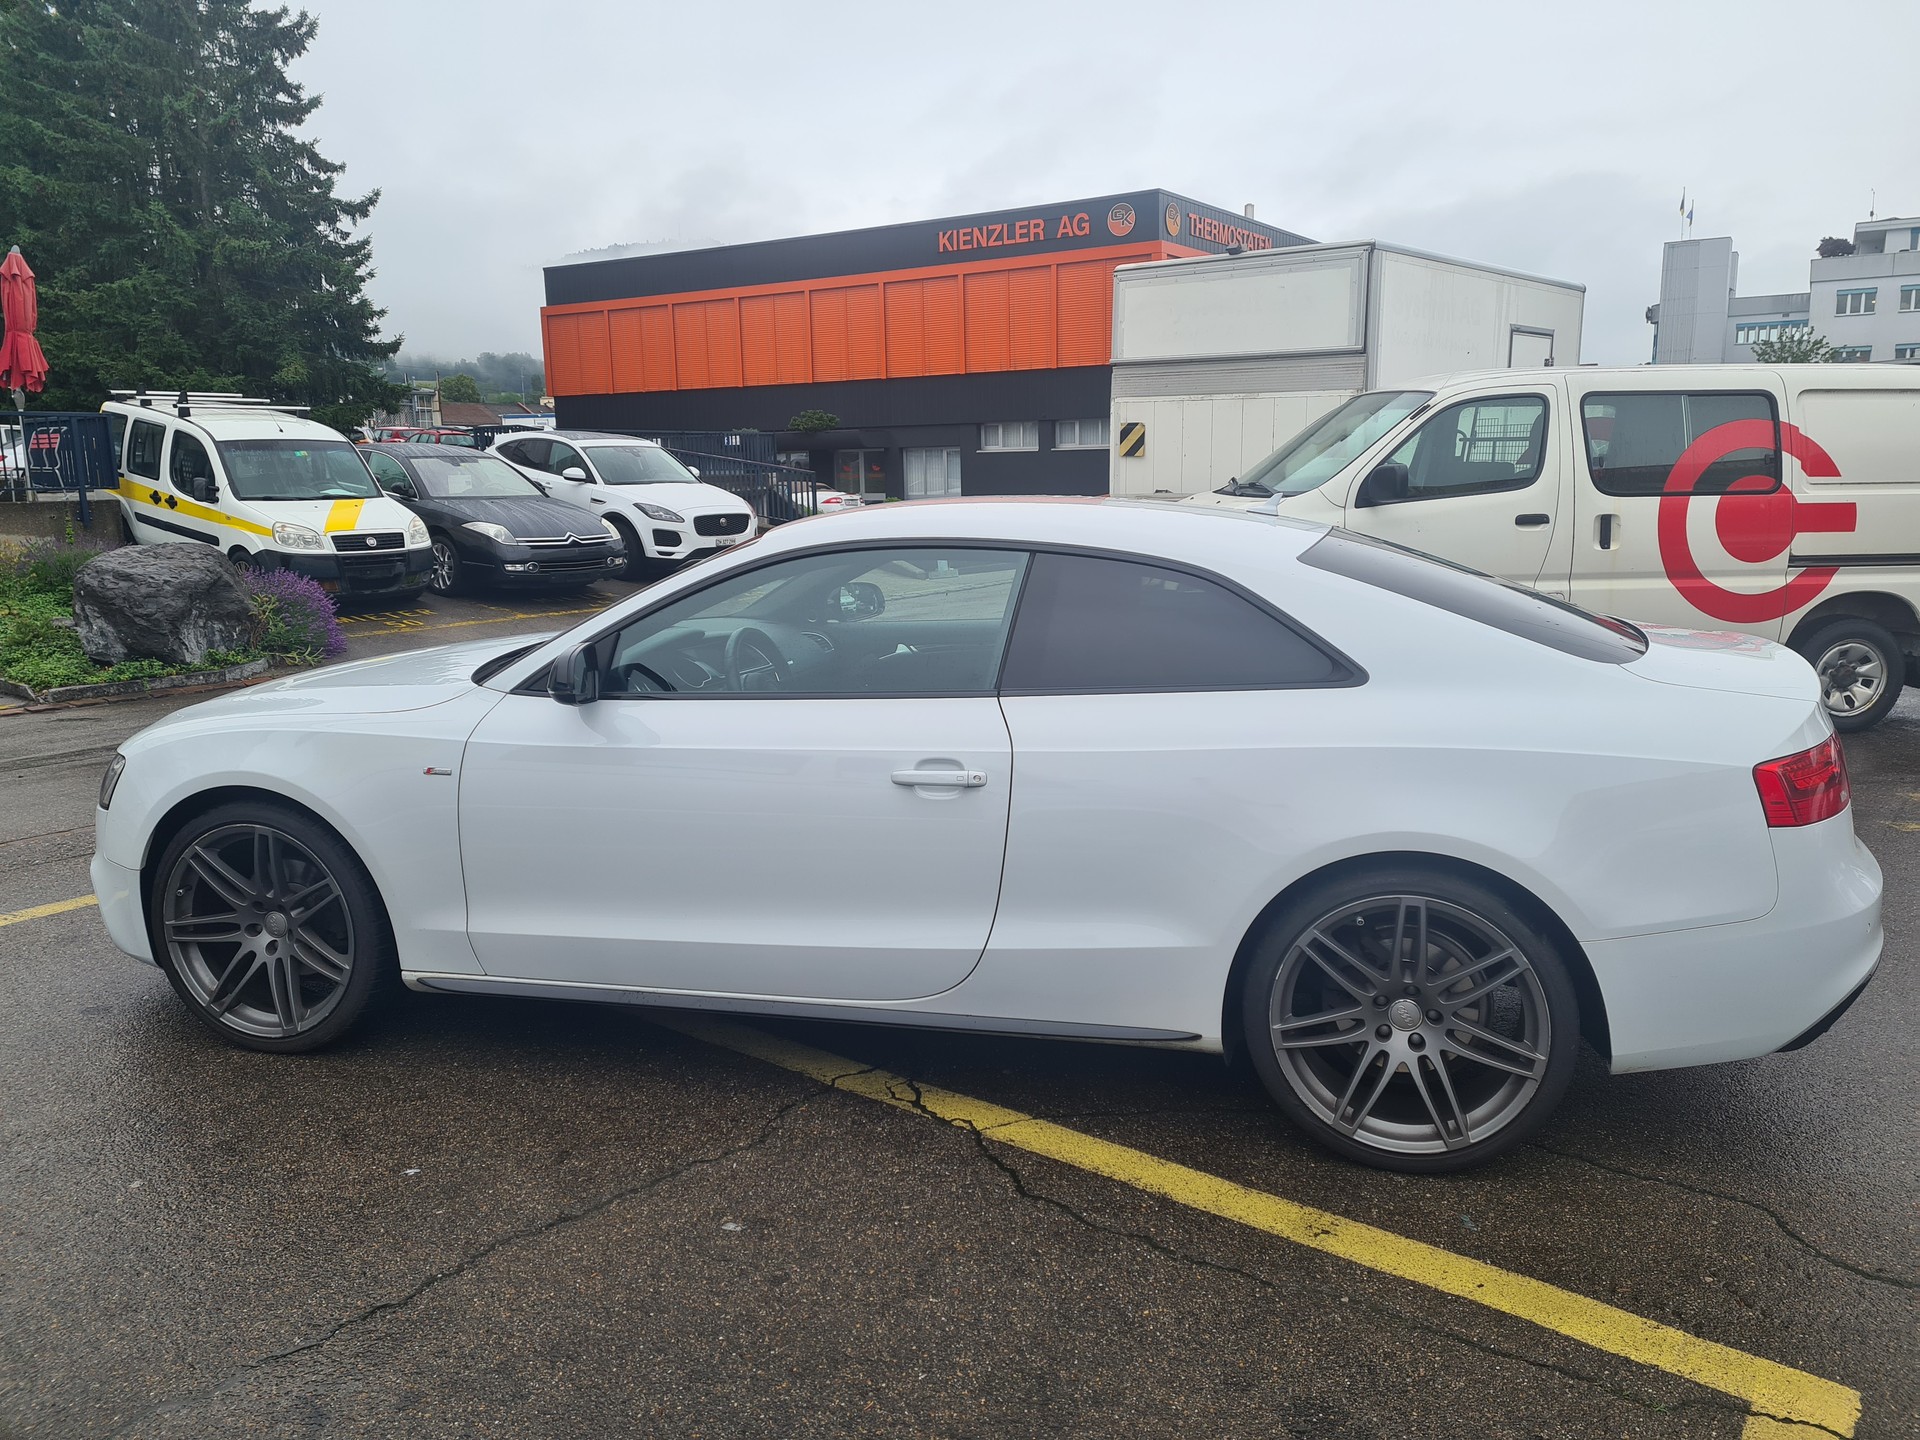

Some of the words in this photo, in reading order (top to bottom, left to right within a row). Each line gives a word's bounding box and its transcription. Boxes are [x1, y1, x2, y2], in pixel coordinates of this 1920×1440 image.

[1110, 209, 1134, 227] GK
[938, 218, 1045, 252] KIENZLER
[1056, 212, 1090, 238] AG
[1187, 212, 1272, 250] THERMOSTATEN
[335, 607, 438, 623] MIETER
[384, 619, 424, 628] 50
